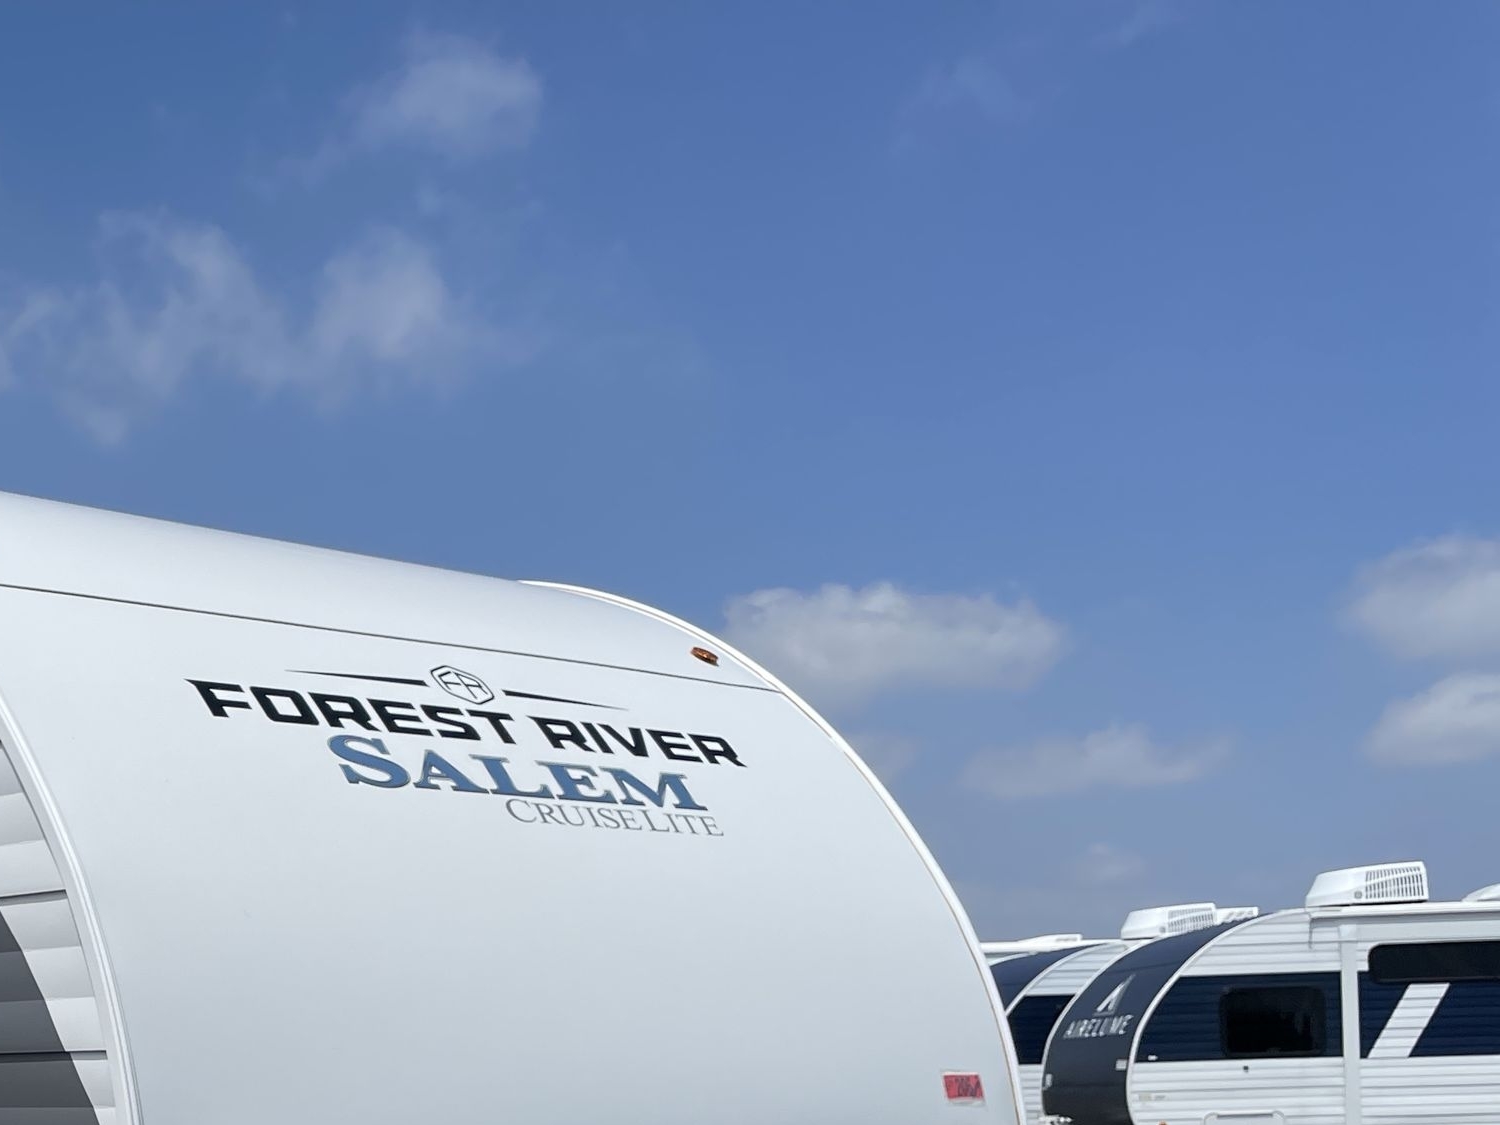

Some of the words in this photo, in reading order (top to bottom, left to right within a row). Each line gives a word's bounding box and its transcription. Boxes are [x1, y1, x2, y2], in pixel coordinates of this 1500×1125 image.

[184, 679, 517, 745] FOREST
[526, 715, 747, 768] RIVER
[327, 735, 708, 811] SALEM
